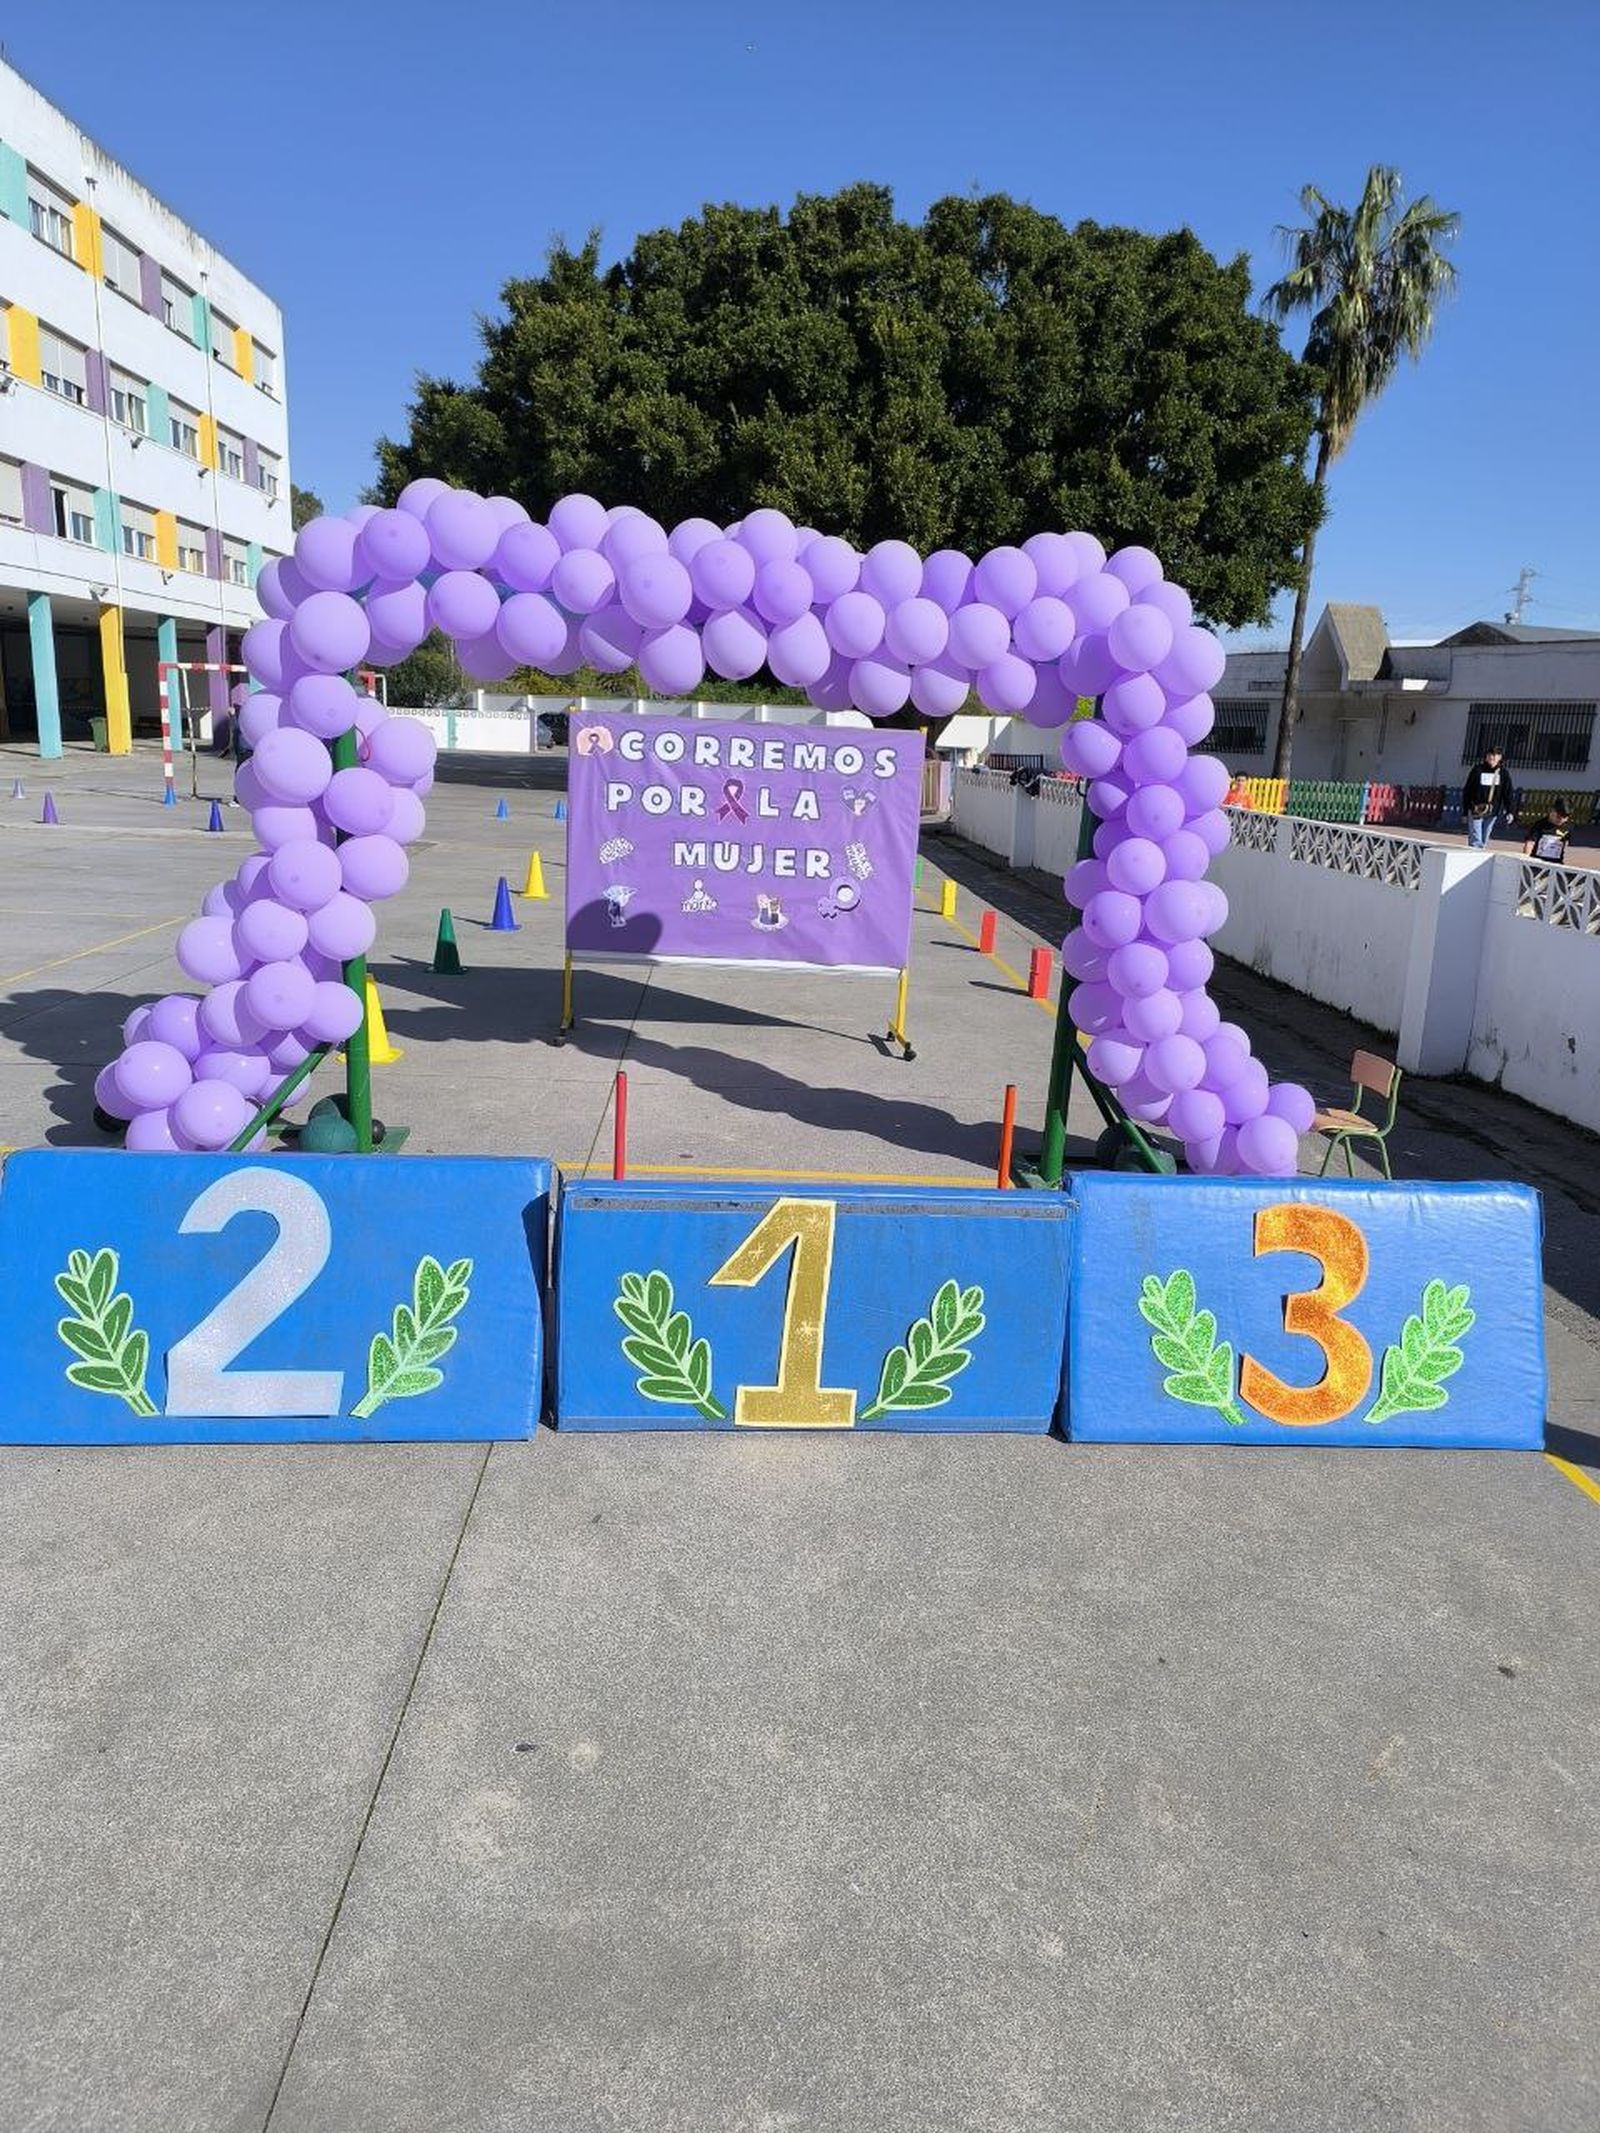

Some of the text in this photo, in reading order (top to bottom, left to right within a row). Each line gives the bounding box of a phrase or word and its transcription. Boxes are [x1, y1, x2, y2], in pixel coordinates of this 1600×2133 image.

[606, 781, 820, 820] POR LA
[619, 731, 897, 779] CORREMOS
[672, 841, 832, 879] MUJER
[165, 1165, 345, 1418] 2
[707, 1197, 857, 1427] 1
[1239, 1203, 1373, 1426] 3
